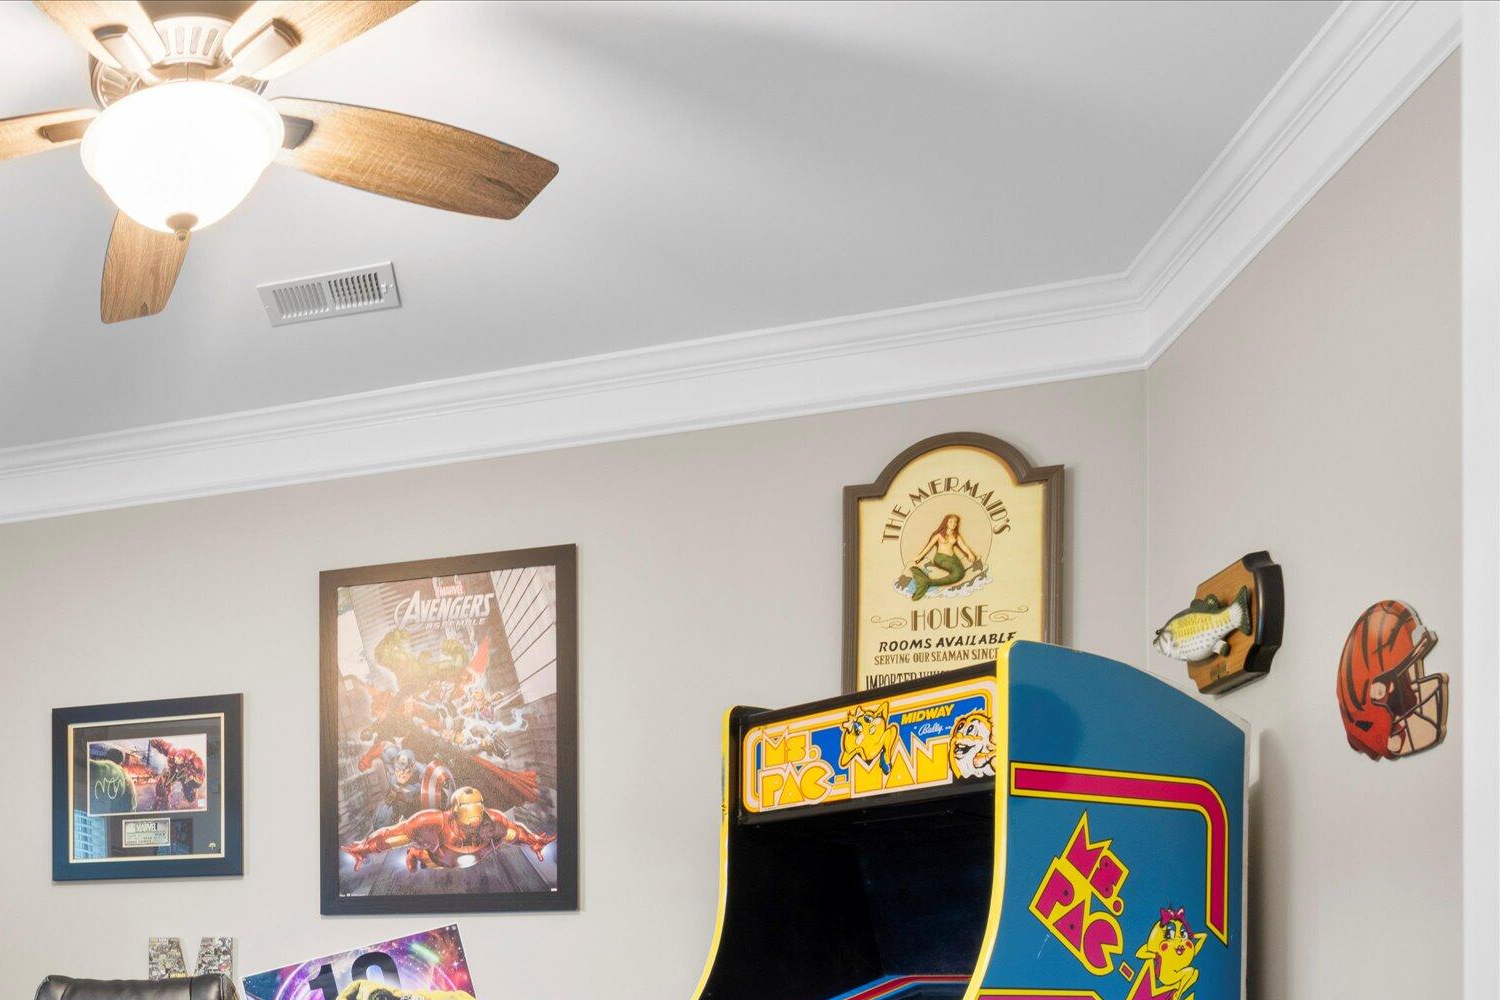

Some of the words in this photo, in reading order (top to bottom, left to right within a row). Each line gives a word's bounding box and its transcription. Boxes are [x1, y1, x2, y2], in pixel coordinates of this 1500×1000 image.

[881, 503, 911, 544] THE
[908, 475, 1012, 537] MERMAID'S
[394, 590, 495, 629] AVENGERS
[910, 604, 989, 632] HOUSE
[874, 653, 911, 666] SERVING
[913, 651, 930, 664] OUR
[931, 649, 970, 662] SEAMAN
[878, 637, 932, 653] ROOMS
[935, 631, 1018, 648] AVAILABLE
[901, 704, 955, 725] MIDWAY
[918, 722, 943, 736] Bally
[763, 731, 819, 770] MS.
[760, 736, 952, 810] PAC-MAN
[1060, 812, 1127, 915] MS.
